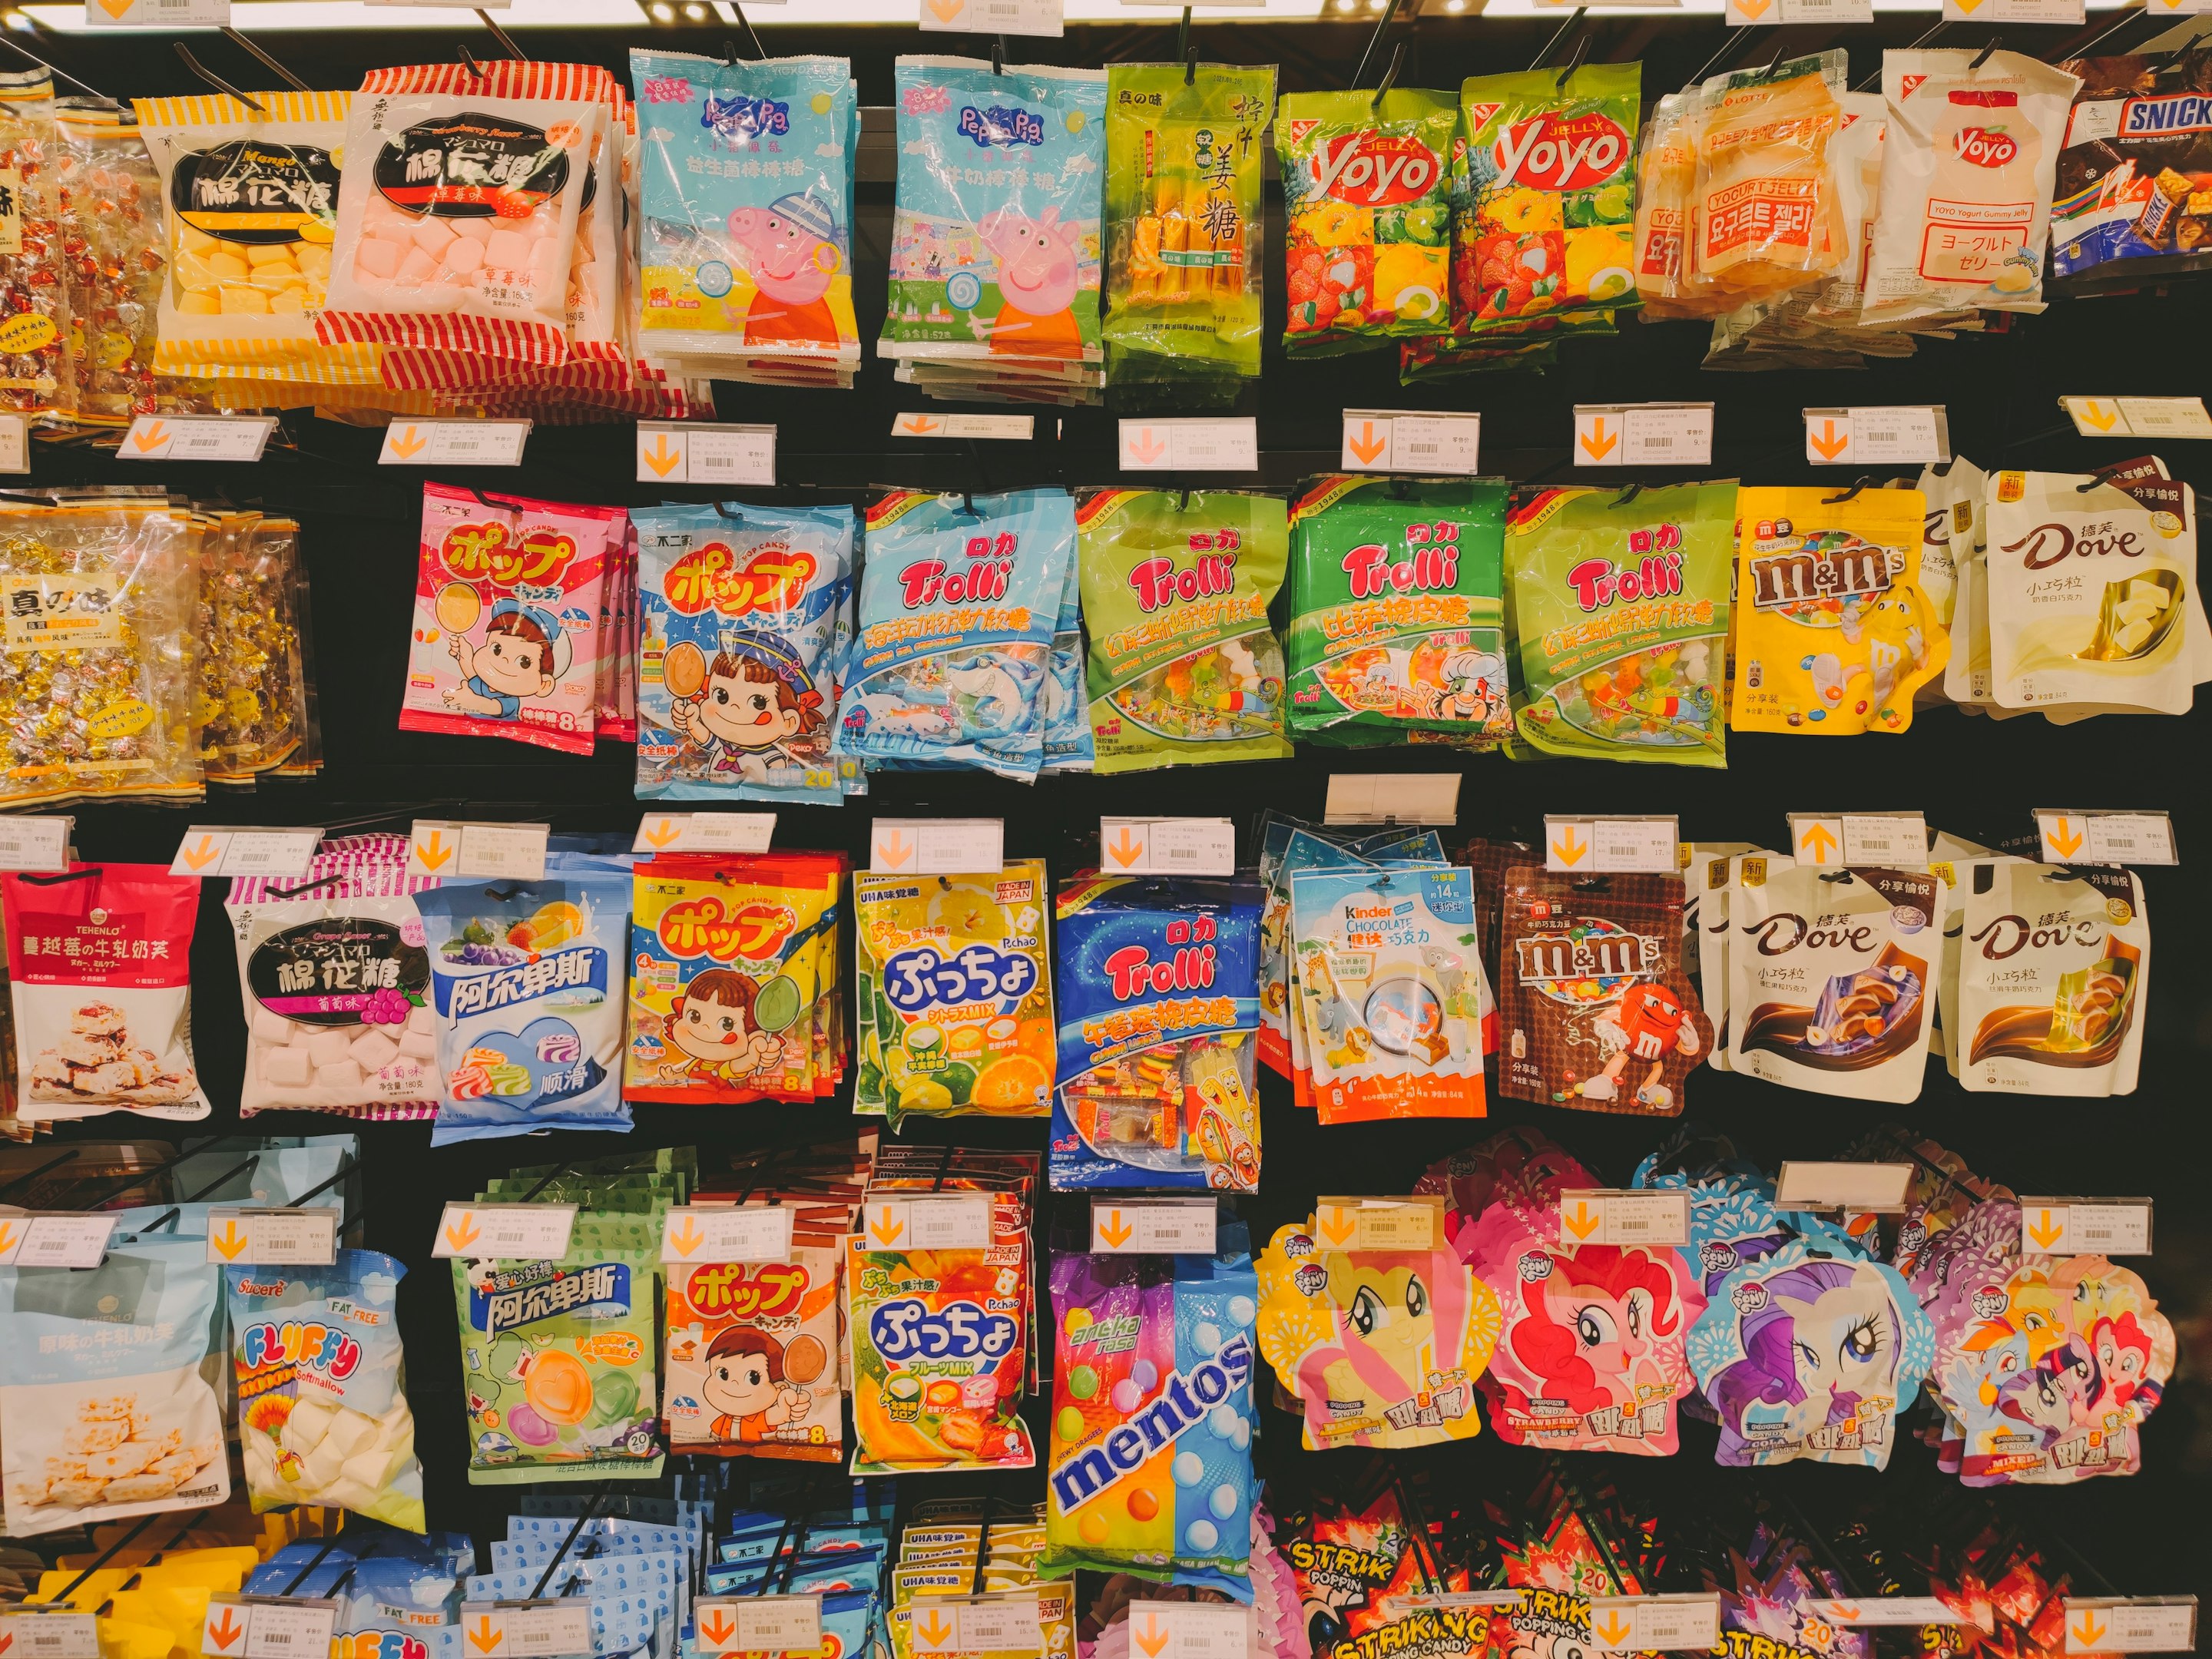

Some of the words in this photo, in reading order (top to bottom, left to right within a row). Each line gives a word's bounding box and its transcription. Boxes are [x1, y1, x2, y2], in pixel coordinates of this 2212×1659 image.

[1118, 90, 1163, 108] 真の味
[1735, 93, 1768, 105] LOTTE
[1562, 104, 1588, 118] TROPICAL
[1588, 100, 1602, 110] FRUIT
[1015, 110, 1044, 144] Pig
[1548, 121, 1604, 136] JELLY
[442, 136, 505, 152] マシュマロ
[1950, 128, 2013, 164] Yoyo
[1979, 134, 2006, 143] JELLY
[1195, 130, 1214, 168] 软糖
[1364, 140, 1418, 154] JELLY
[242, 150, 296, 167] Mango
[1492, 120, 1621, 191] Yoyo
[687, 155, 806, 179] 益生菌棒棒糖
[1305, 137, 1430, 204] Yoyo
[435, 187, 486, 201] 草莓味
[1200, 143, 1241, 243] 姜糖
[1934, 205, 1956, 215] YOYO
[1959, 207, 1982, 218] Yogurt
[1984, 210, 2012, 219] Gummy
[2013, 208, 2028, 219] Jelly
[1710, 202, 1771, 243] 요구르트
[1774, 203, 1812, 232] 젤리
[1941, 234, 2013, 253] ヨーグルト
[1960, 256, 2002, 272] ゼリー
[2003, 254, 2031, 267] Gummy
[484, 268, 536, 289] 草莓味
[901, 329, 952, 341] 净含量:52克
[2005, 474, 2021, 490] 新
[2003, 490, 2019, 499] 包装
[2133, 486, 2180, 502] 分享愉悦
[1406, 520, 1460, 545] 口力
[2081, 521, 2114, 538] 德芙
[656, 535, 693, 547] 不二家
[965, 531, 1018, 558] 口力
[1187, 528, 1241, 552] 口力
[1628, 522, 1682, 555] 口力
[1999, 522, 2146, 571] Dove
[448, 528, 571, 581] ポップ
[672, 549, 811, 610] ポップ
[1341, 544, 1461, 599] Trolli
[898, 558, 1014, 610] Trolli
[1128, 553, 1237, 614] Trolli
[1567, 551, 1684, 613] Trolli
[2026, 576, 2084, 596] 小巧粒
[2032, 593, 2084, 604] 奶香白巧克力
[558, 617, 592, 632] 安全纸棒
[1322, 593, 1470, 640] 比萨橡皮糖
[864, 606, 1032, 650] 海洋动物弹力软糖
[1746, 693, 1780, 704] 分享装
[1766, 707, 1782, 717] 160克
[558, 712, 576, 732] 8
[637, 745, 678, 757] 安全纸棒
[804, 770, 833, 788] 20
[1747, 861, 1762, 876] 新
[1431, 873, 1457, 883] 分享装
[2091, 873, 2129, 888] 分享愉悦
[657, 885, 687, 896] 不二家
[996, 882, 1016, 891] MADE
[1878, 879, 1930, 896] 分享愉悦
[860, 889, 920, 902] UHA味覚糖
[995, 890, 1031, 901] JAPAN
[731, 902, 745, 913] POP
[746, 896, 774, 906] CANDY
[1346, 905, 1393, 919] Kinder
[1431, 901, 1465, 914] 迷你型
[1346, 917, 1413, 932] CHOCOLATE
[1526, 919, 1572, 929] 牛奶巧克力豆
[1816, 913, 1852, 927] 德芙
[2037, 910, 2071, 928] 德芙
[75, 925, 121, 936] TEHENLO
[312, 930, 343, 942] Grape
[666, 902, 790, 957] ポップ
[911, 926, 951, 941] 果汁感!
[1166, 915, 1218, 945] 口力
[1387, 929, 1430, 946] 巧克力
[1740, 912, 1879, 956] Dove
[1969, 914, 2101, 961] Dove
[22, 935, 170, 962] 蔓越莓の牛轧奶芙
[733, 957, 781, 975] キャンディ
[1104, 943, 1218, 1002] Trolli
[1757, 967, 1806, 981] 小巧粒
[276, 957, 402, 994] 棉花糖
[889, 952, 1030, 1005] ぷっちょ
[1986, 969, 2038, 985] 小巧粒
[448, 948, 594, 1031] 阿尔卑斯
[1988, 985, 2042, 994] 丝滑牛奶巧克力
[318, 996, 362, 1012] 葡萄味
[928, 1002, 998, 1025] シトラスMIX
[630, 1045, 666, 1056] 安全纸棒
[376, 1066, 425, 1080] 葡萄味
[1512, 1061, 1539, 1076] 分享装
[378, 1079, 425, 1092] 净含量:180克
[538, 1065, 590, 1098] 顺滑
[783, 1075, 800, 1091] 8
[985, 1253, 1020, 1263] JAPAN
[988, 1246, 1005, 1254] MADE
[495, 1260, 553, 1291] 爱心好棒
[694, 1263, 805, 1316] ポップ
[901, 1280, 939, 1293] 果汁感!
[331, 1300, 351, 1315] FAT
[353, 1310, 379, 1325] FREE
[486, 1265, 617, 1345] 阿尔卑斯
[754, 1315, 800, 1330] キャンディ
[876, 1303, 1012, 1355] ぷっちょ
[243, 1323, 363, 1380] FLUFFY
[1096, 1336, 1137, 1354] rasa
[909, 1359, 975, 1376] フルーツMIX
[671, 1406, 701, 1416] 安全纸棒
[889, 1399, 918, 1411] 北海道
[1329, 1401, 1362, 1409] POPPING
[1529, 1406, 1566, 1416] CANDY
[1532, 1399, 1566, 1407] POPPING
[890, 1409, 918, 1420] メロン
[1329, 1409, 1363, 1419] CANDY
[1507, 1416, 1582, 1427] STRAWBERRY
[1050, 1333, 1253, 1517] mentos
[1326, 1417, 1371, 1433] MANGO
[631, 1433, 647, 1446] 20
[810, 1426, 826, 1445] 8
[1075, 1426, 1104, 1449] DRAGEES
[1750, 1430, 1786, 1439] CANDY
[1750, 1438, 1785, 1448] COLA
[1995, 1442, 2031, 1452] CANDY
[1992, 1453, 2035, 1467] MIXED
[911, 1532, 966, 1544] UHA味覚糖
[739, 1545, 764, 1558] 不二家
[1196, 1560, 1220, 1571] BUAH
[902, 1576, 959, 1587] UHA味覚糖
[1584, 1567, 1607, 1591] 20
[385, 1606, 403, 1619] FAT
[409, 1614, 441, 1625] FREE
[1512, 1615, 1577, 1641] POPPING
[1803, 1618, 1831, 1644] 20
[1422, 1637, 1472, 1656] CANDY
